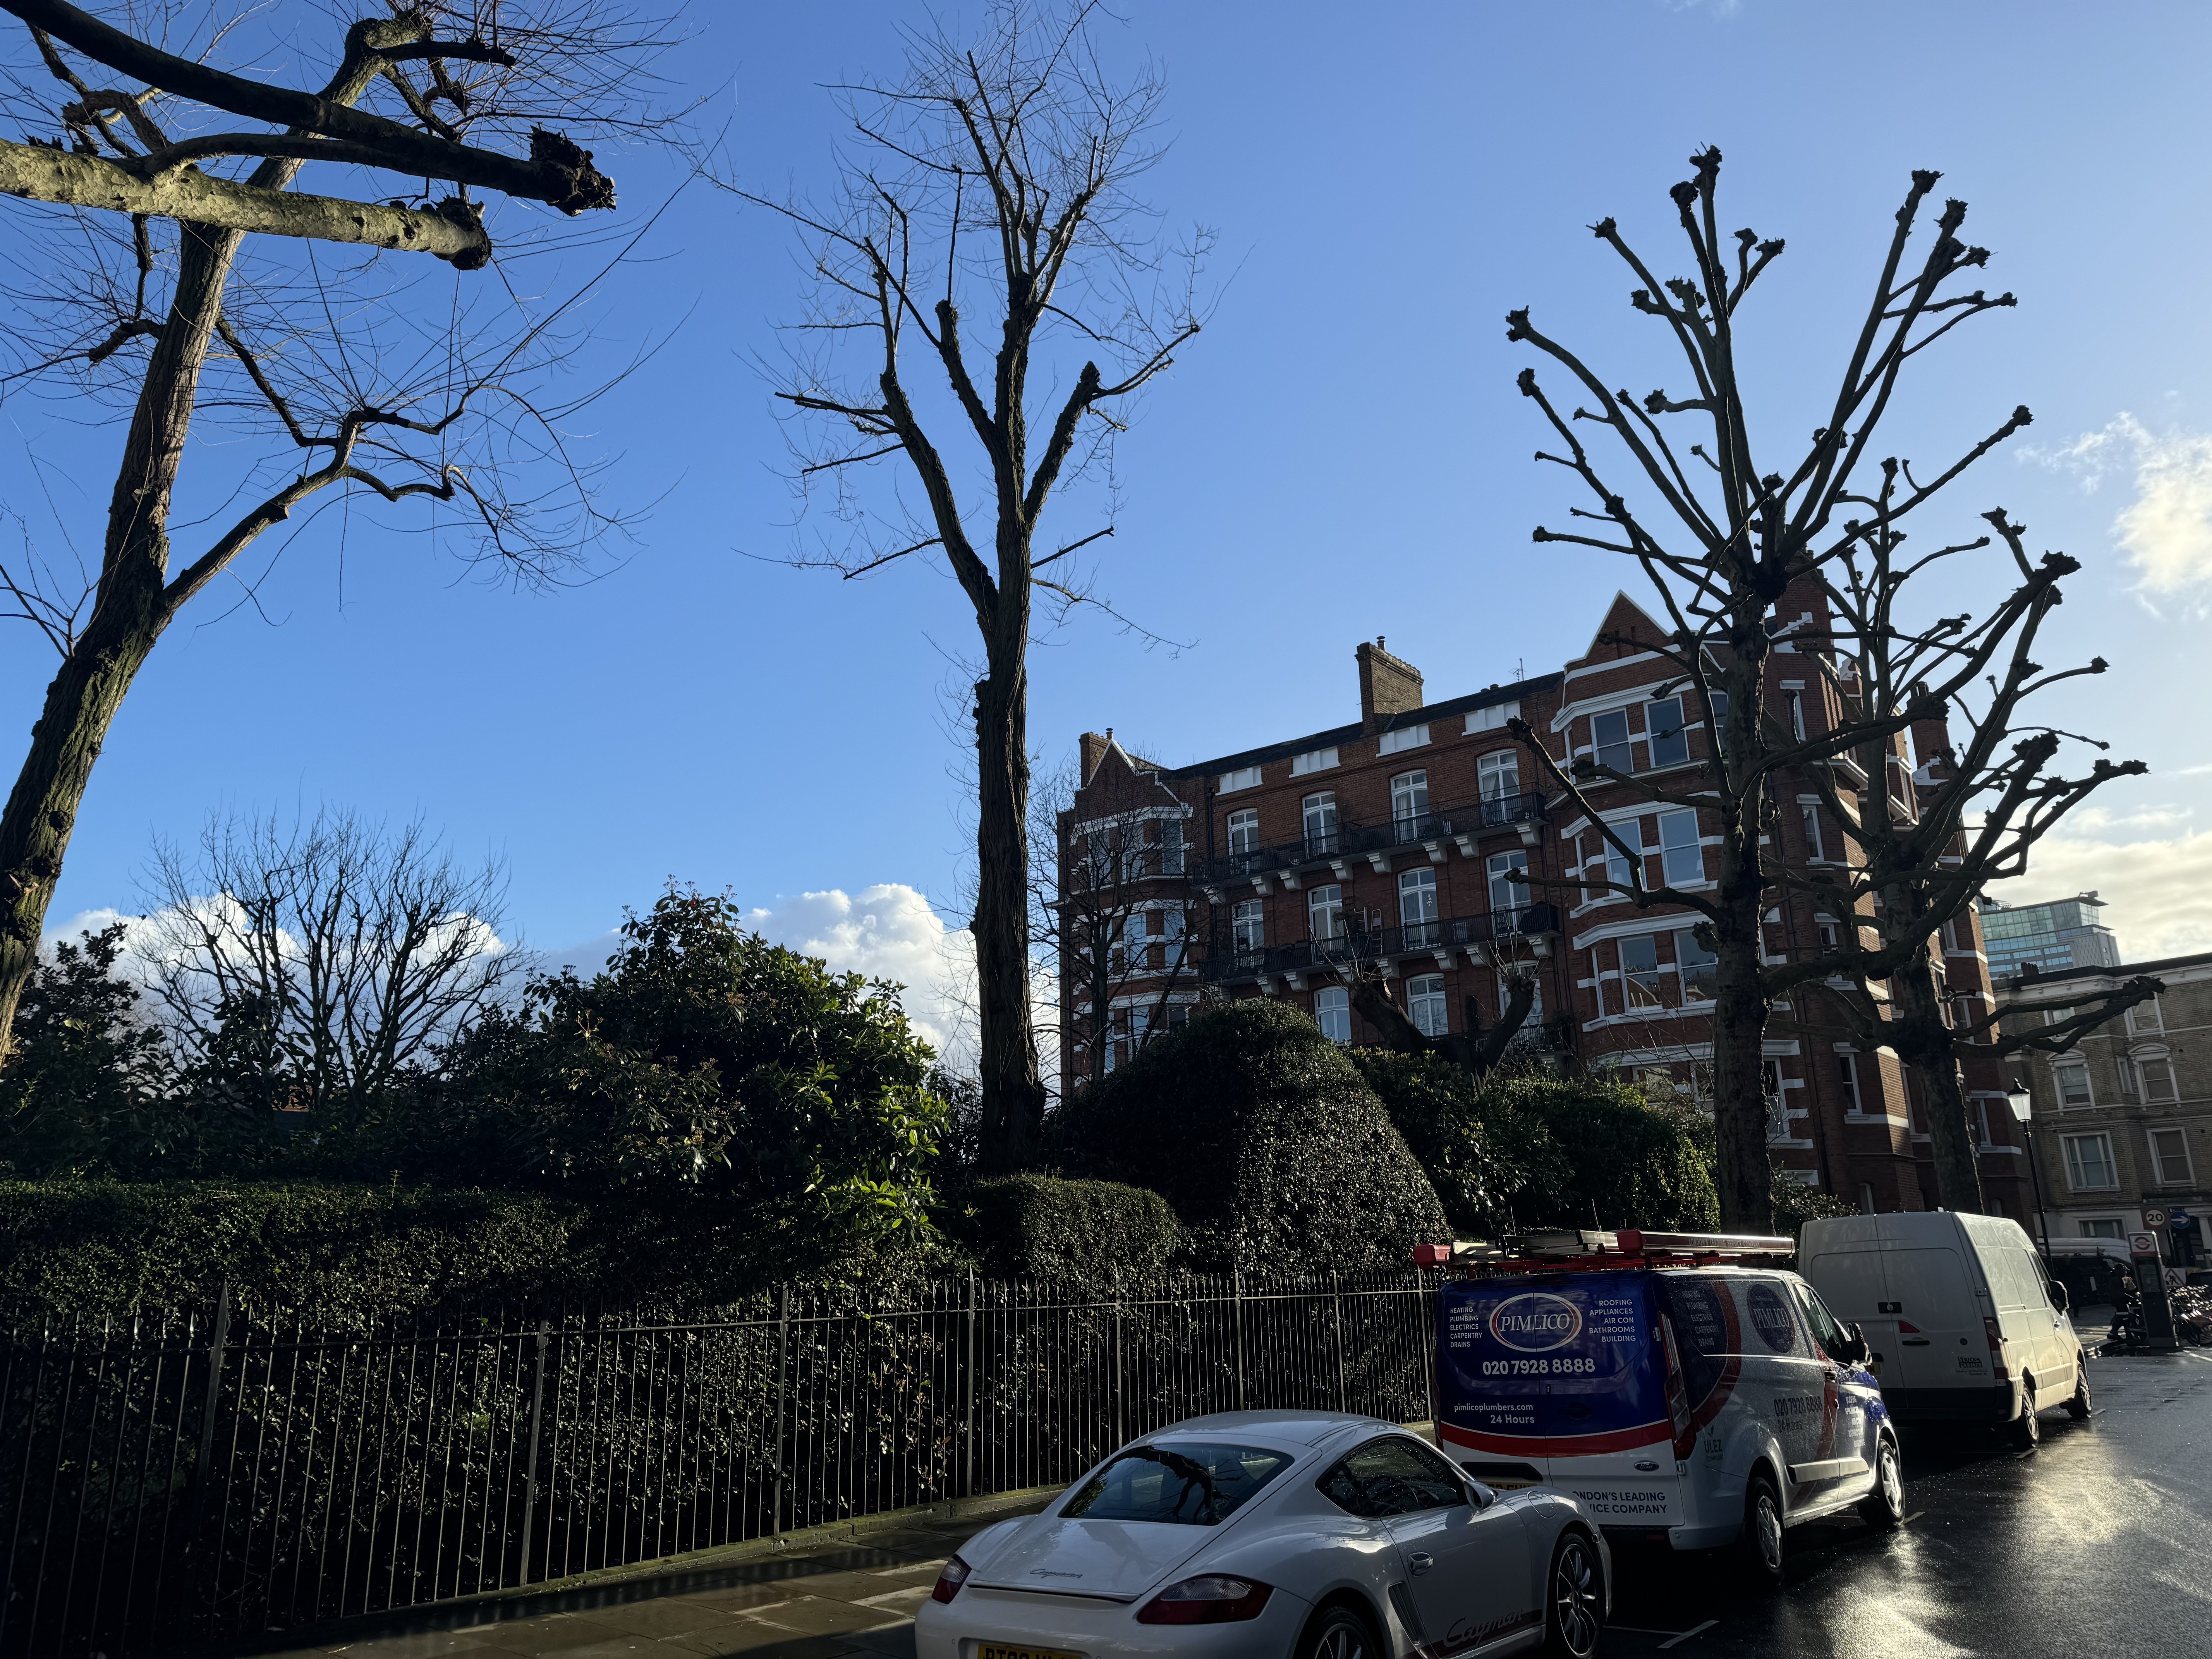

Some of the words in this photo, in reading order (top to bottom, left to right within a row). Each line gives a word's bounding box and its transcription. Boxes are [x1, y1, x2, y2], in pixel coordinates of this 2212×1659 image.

[1500, 1314, 1570, 1331] PIMLICO
[1752, 1308, 1790, 1328] PIMLICO
[1482, 1360, 1508, 1375] 020
[1511, 1359, 1549, 1374] 7928
[1552, 1358, 1595, 1373] 8888
[1454, 1403, 1533, 1413] pimlicoplumbers.com
[1774, 1399, 1788, 1416] 020
[1788, 1397, 1806, 1415] 7928
[1805, 1396, 1823, 1413] 8888
[1490, 1415, 1503, 1424] 24
[1505, 1414, 1535, 1424] Hours
[1704, 1439, 1723, 1453] ULEZ
[1572, 1491, 1617, 1501] NDON'S
[1620, 1492, 1666, 1501] LEADING
[1612, 1504, 1667, 1513] COMPANY
[1443, 1608, 1523, 1648] Cayman
